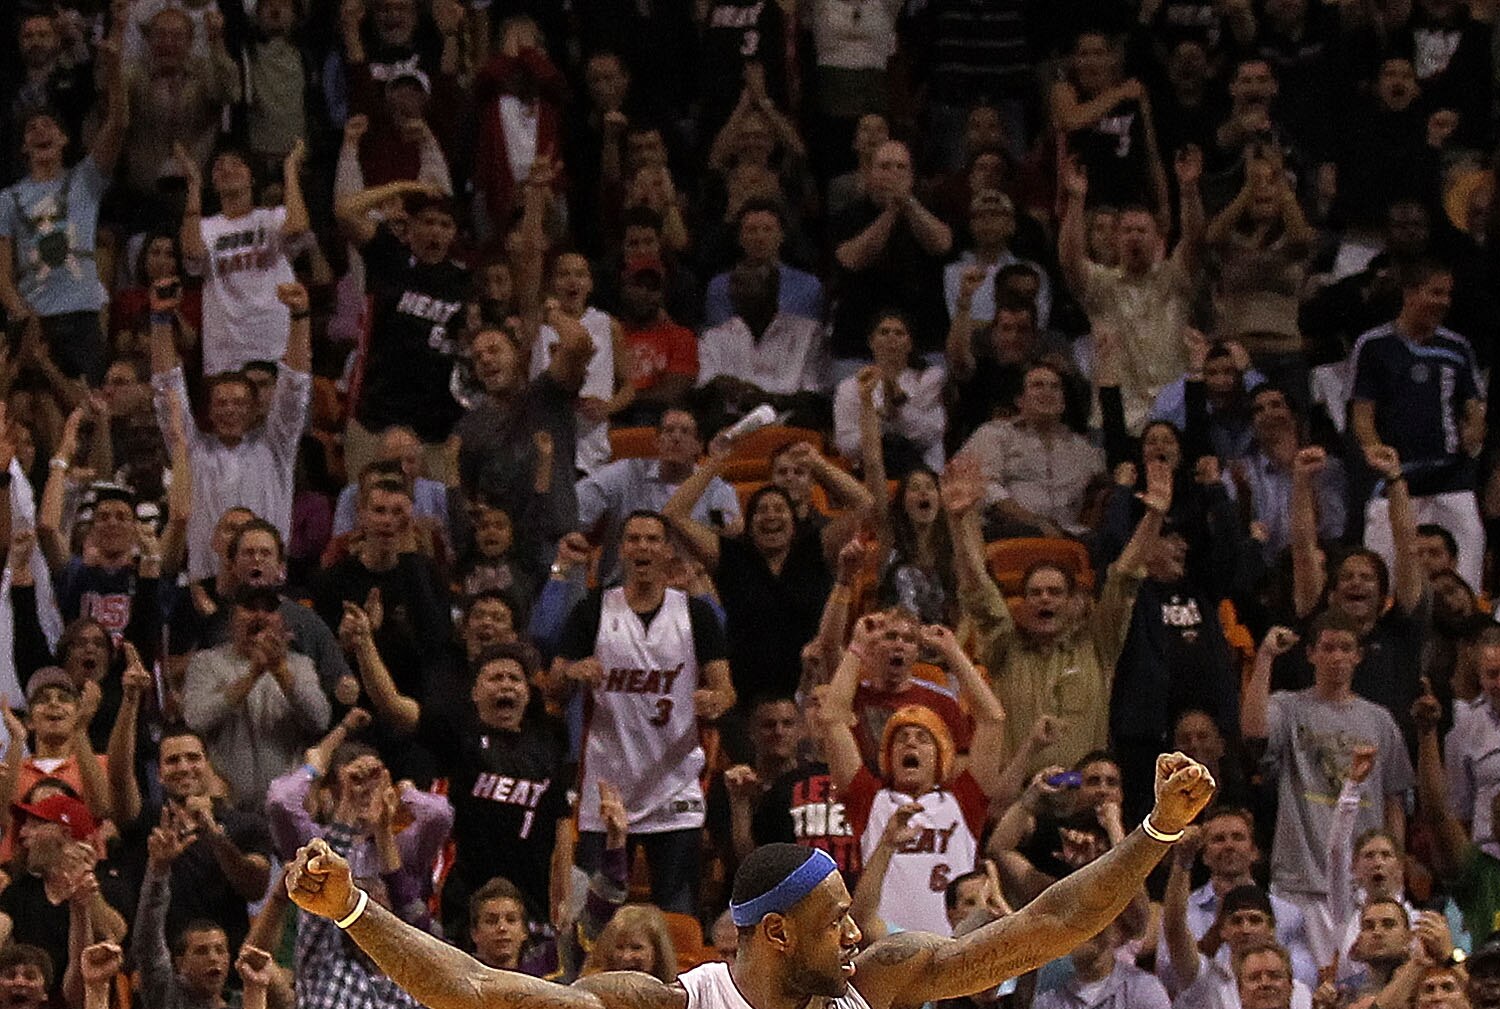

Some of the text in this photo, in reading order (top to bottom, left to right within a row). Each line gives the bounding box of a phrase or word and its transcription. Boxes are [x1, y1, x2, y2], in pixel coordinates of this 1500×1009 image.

[602, 661, 687, 695] HEAT
[650, 697, 676, 729] 3
[471, 771, 553, 809] HEAT
[518, 809, 536, 842] 1
[895, 820, 958, 855] EAT
[929, 863, 951, 894] 6
